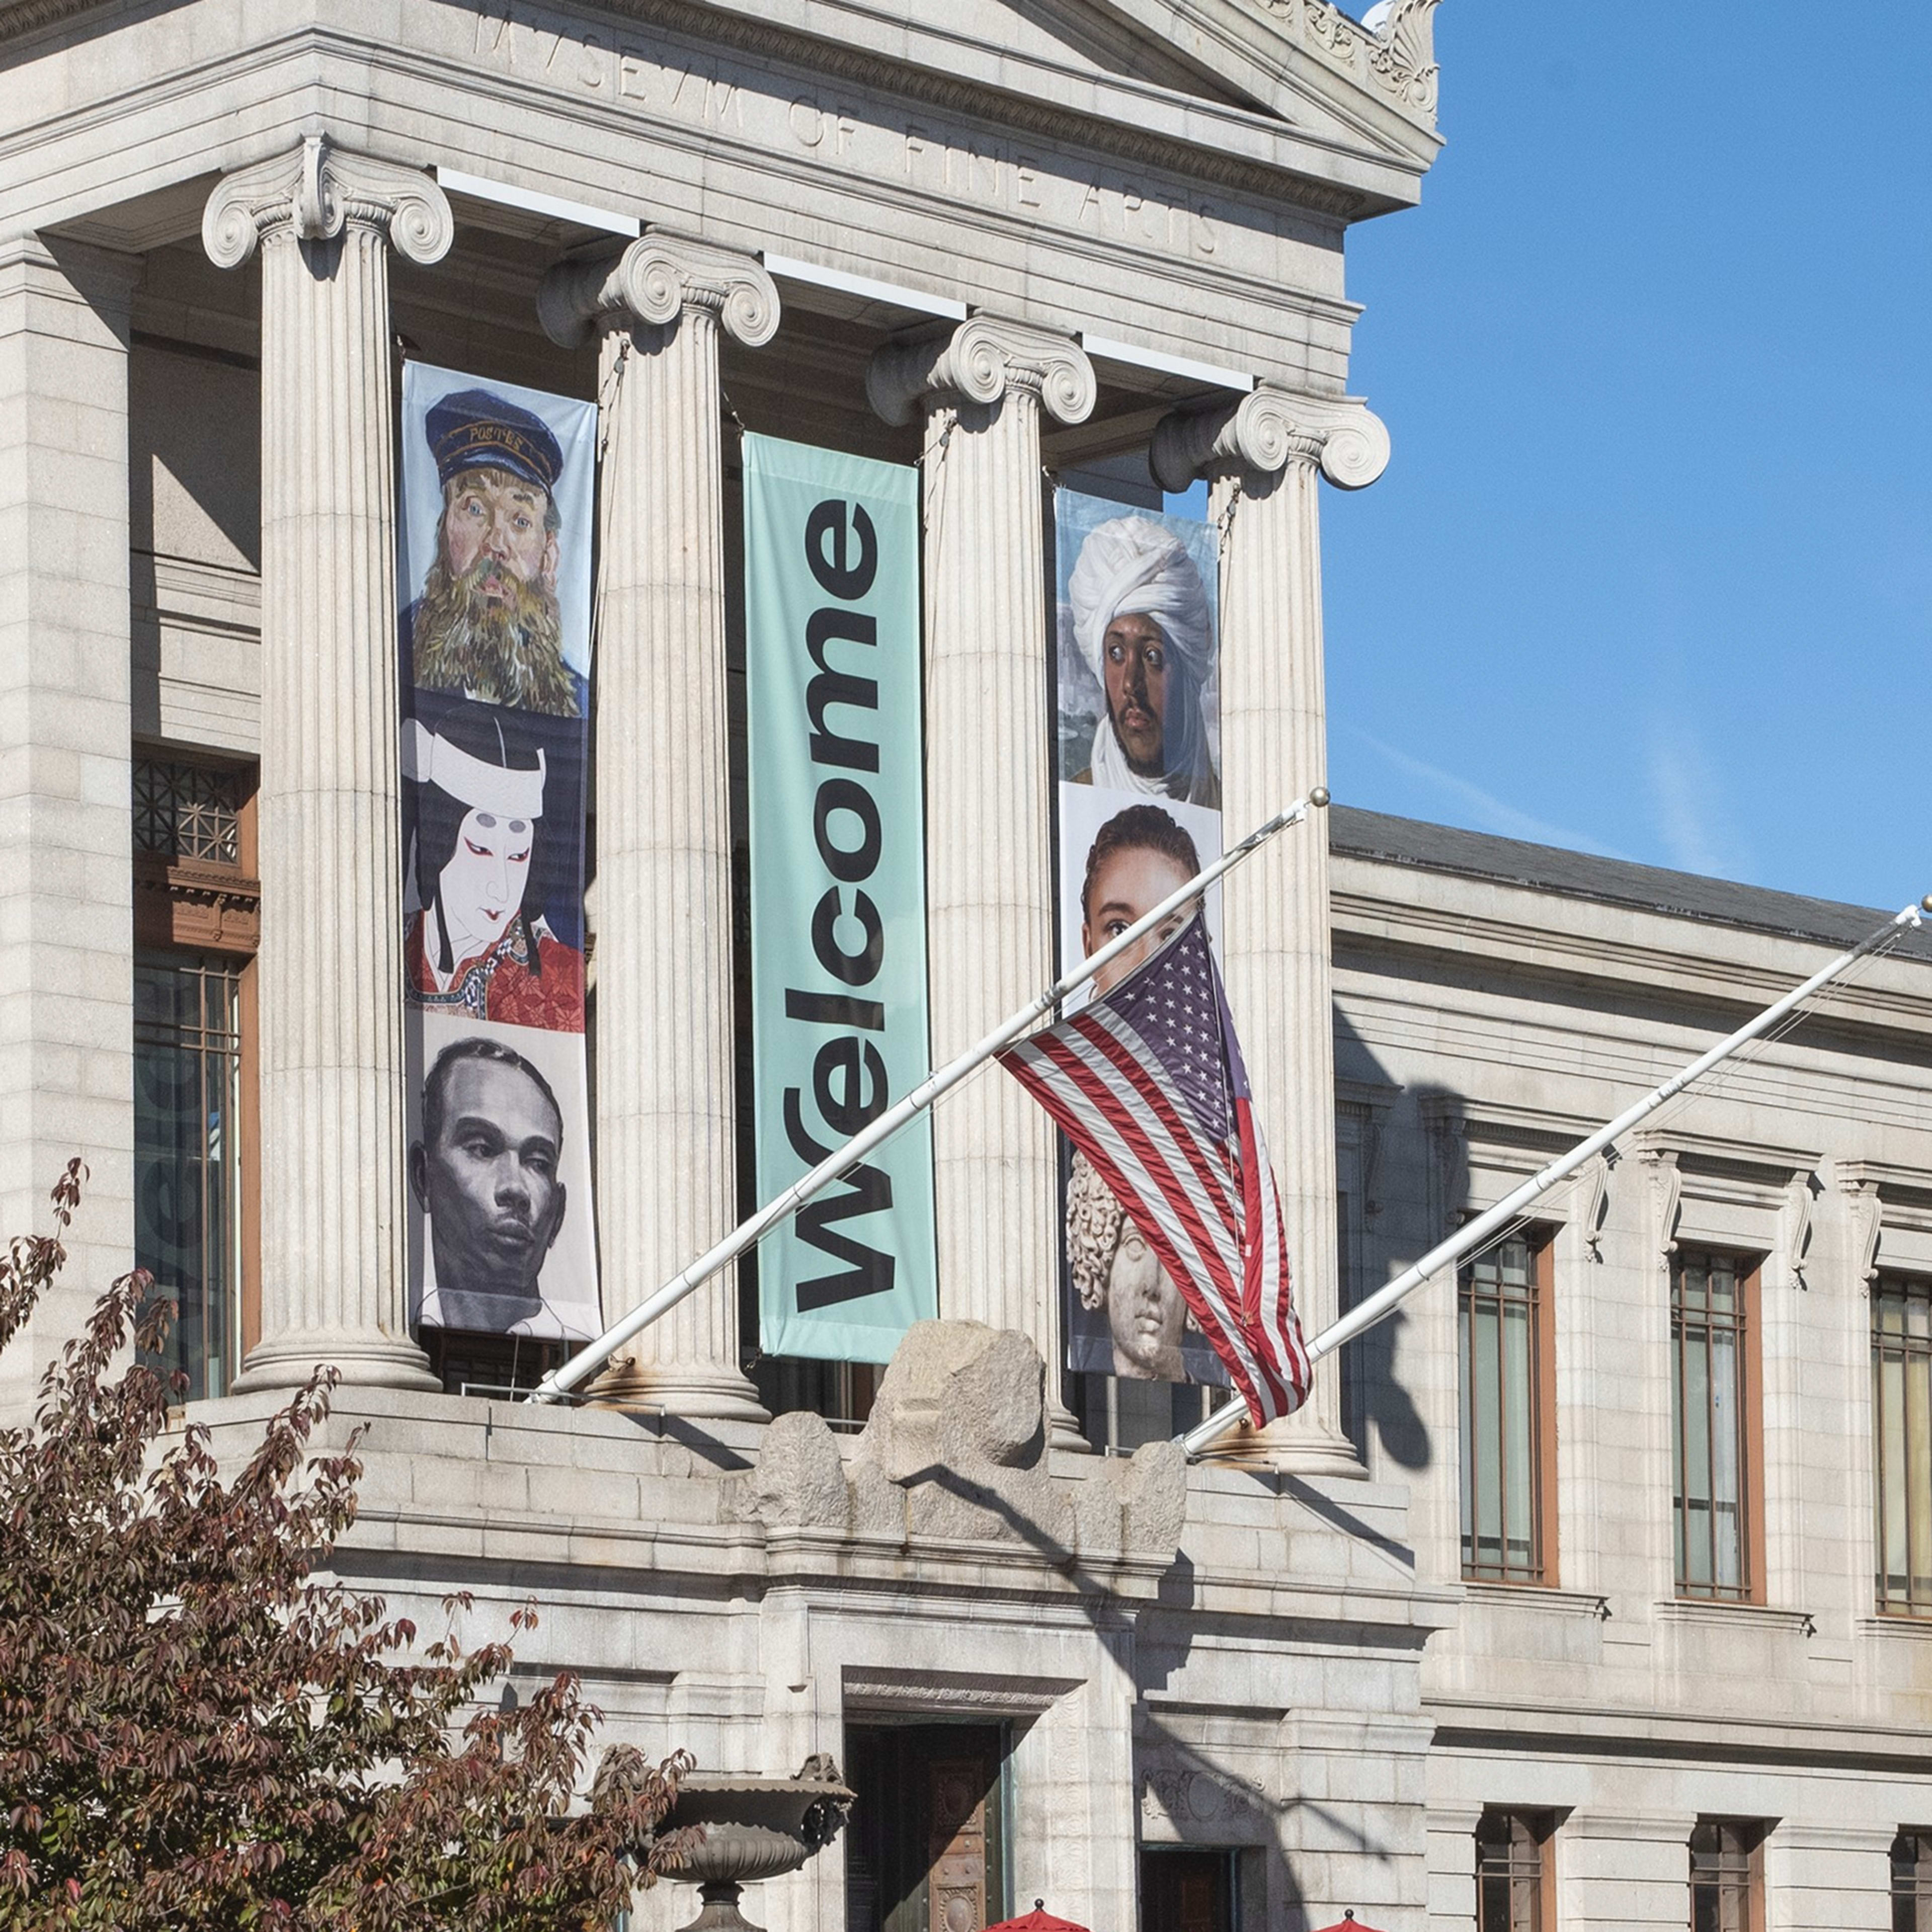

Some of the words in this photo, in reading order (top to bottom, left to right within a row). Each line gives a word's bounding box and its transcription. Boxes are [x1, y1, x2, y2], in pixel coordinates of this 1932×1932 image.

[788, 94, 859, 155] OF
[905, 124, 1040, 208] FINE
[1078, 175, 1216, 254] ARTS
[470, 427, 524, 453] POSTES
[783, 499, 896, 1314] Welcome
